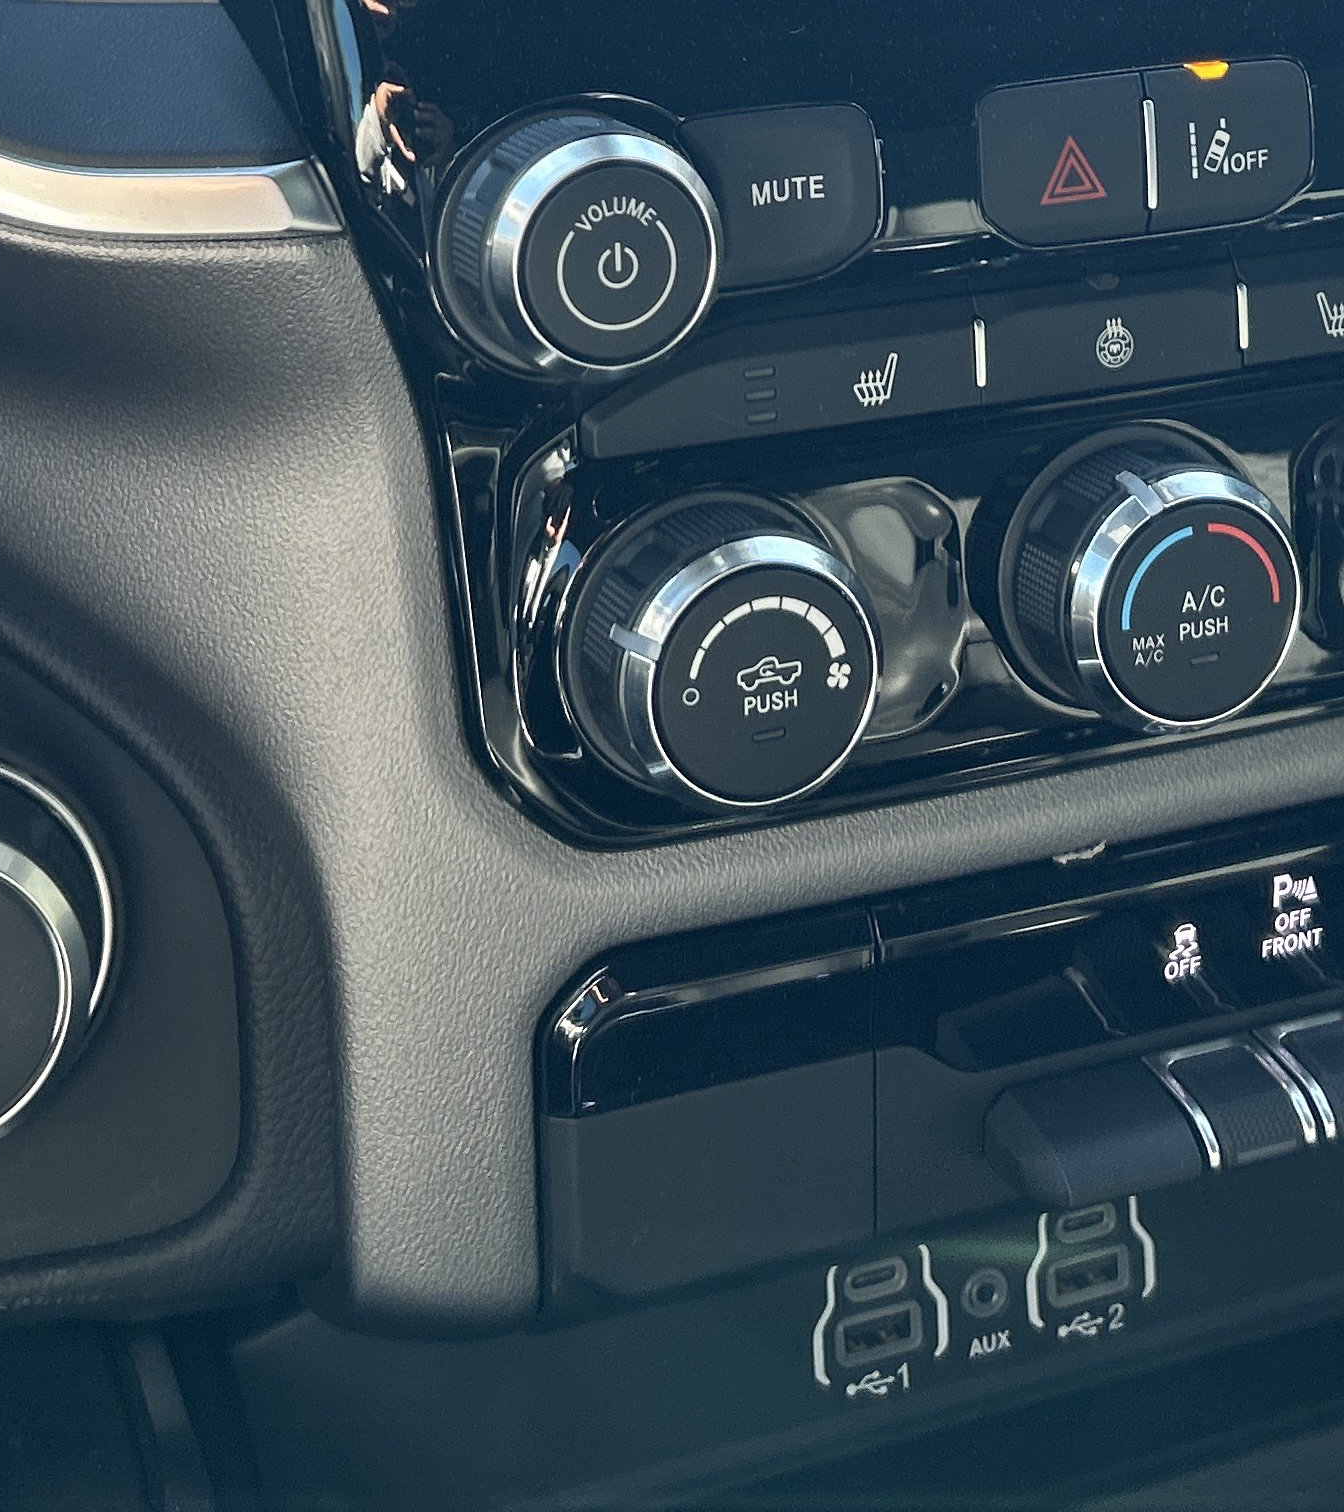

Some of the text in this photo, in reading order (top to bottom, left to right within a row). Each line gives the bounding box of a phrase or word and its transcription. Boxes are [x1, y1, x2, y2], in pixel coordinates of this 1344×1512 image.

[1230, 148, 1269, 174] OFF
[750, 174, 826, 207] MUTE
[575, 196, 658, 234] VOLUME
[1181, 583, 1227, 614] A/C
[1132, 633, 1166, 651] MAX
[1178, 615, 1230, 641] PUSH
[1134, 648, 1165, 668] A/C
[743, 688, 799, 717] PUSH
[1273, 907, 1313, 934] OFF
[1261, 927, 1324, 959] FRONT
[1163, 955, 1202, 982] OFF
[1107, 1302, 1126, 1331] 2
[968, 1329, 1012, 1358] AUX
[896, 1362, 911, 1389] 1
